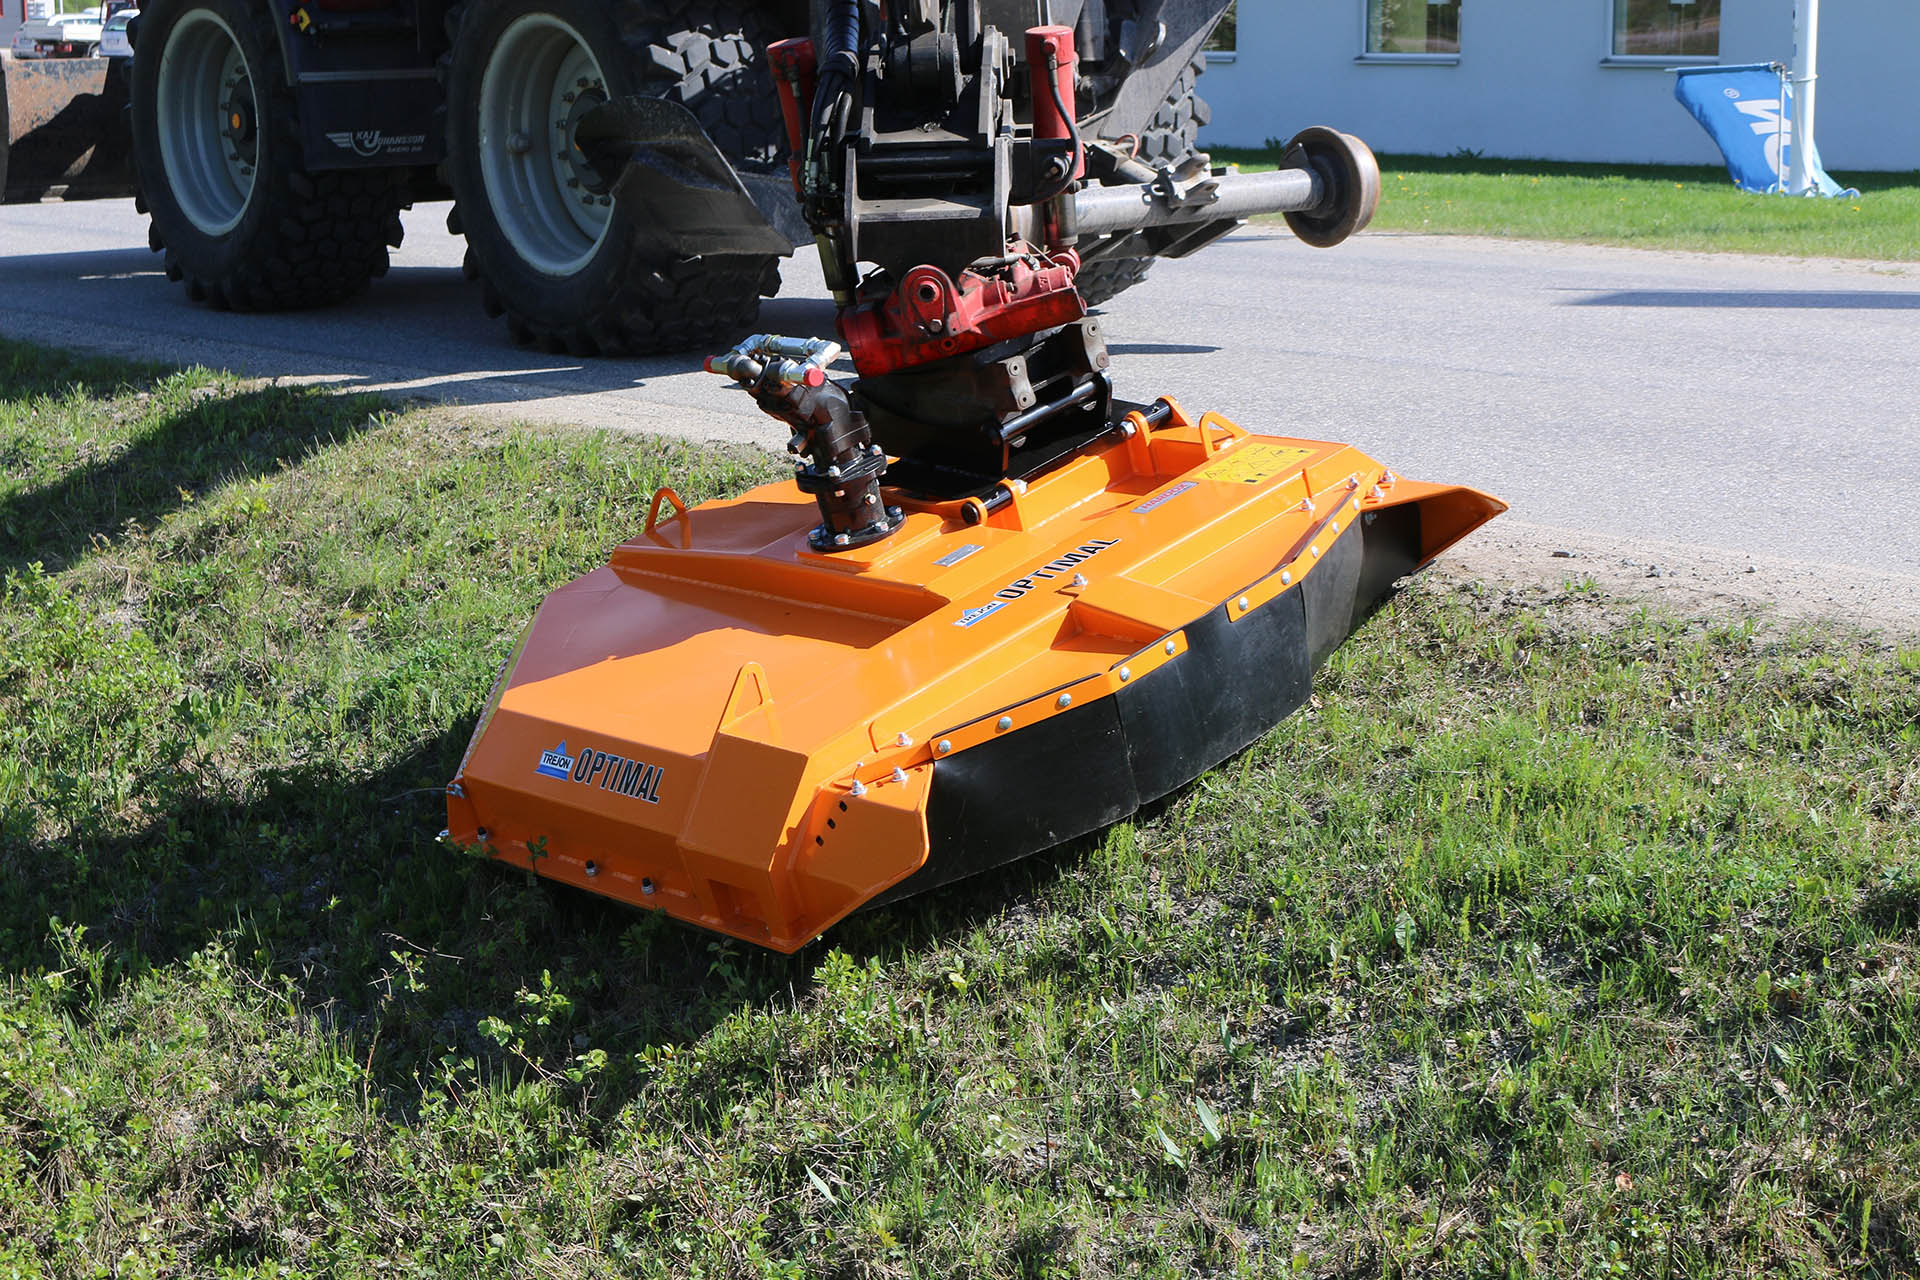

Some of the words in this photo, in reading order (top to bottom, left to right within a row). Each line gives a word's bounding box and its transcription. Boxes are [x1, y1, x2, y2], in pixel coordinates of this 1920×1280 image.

[959, 603, 998, 624] TREJON
[995, 537, 1121, 600] OPTIMAL
[542, 753, 571, 769] TREJON
[573, 747, 664, 804] OPTIMAL
